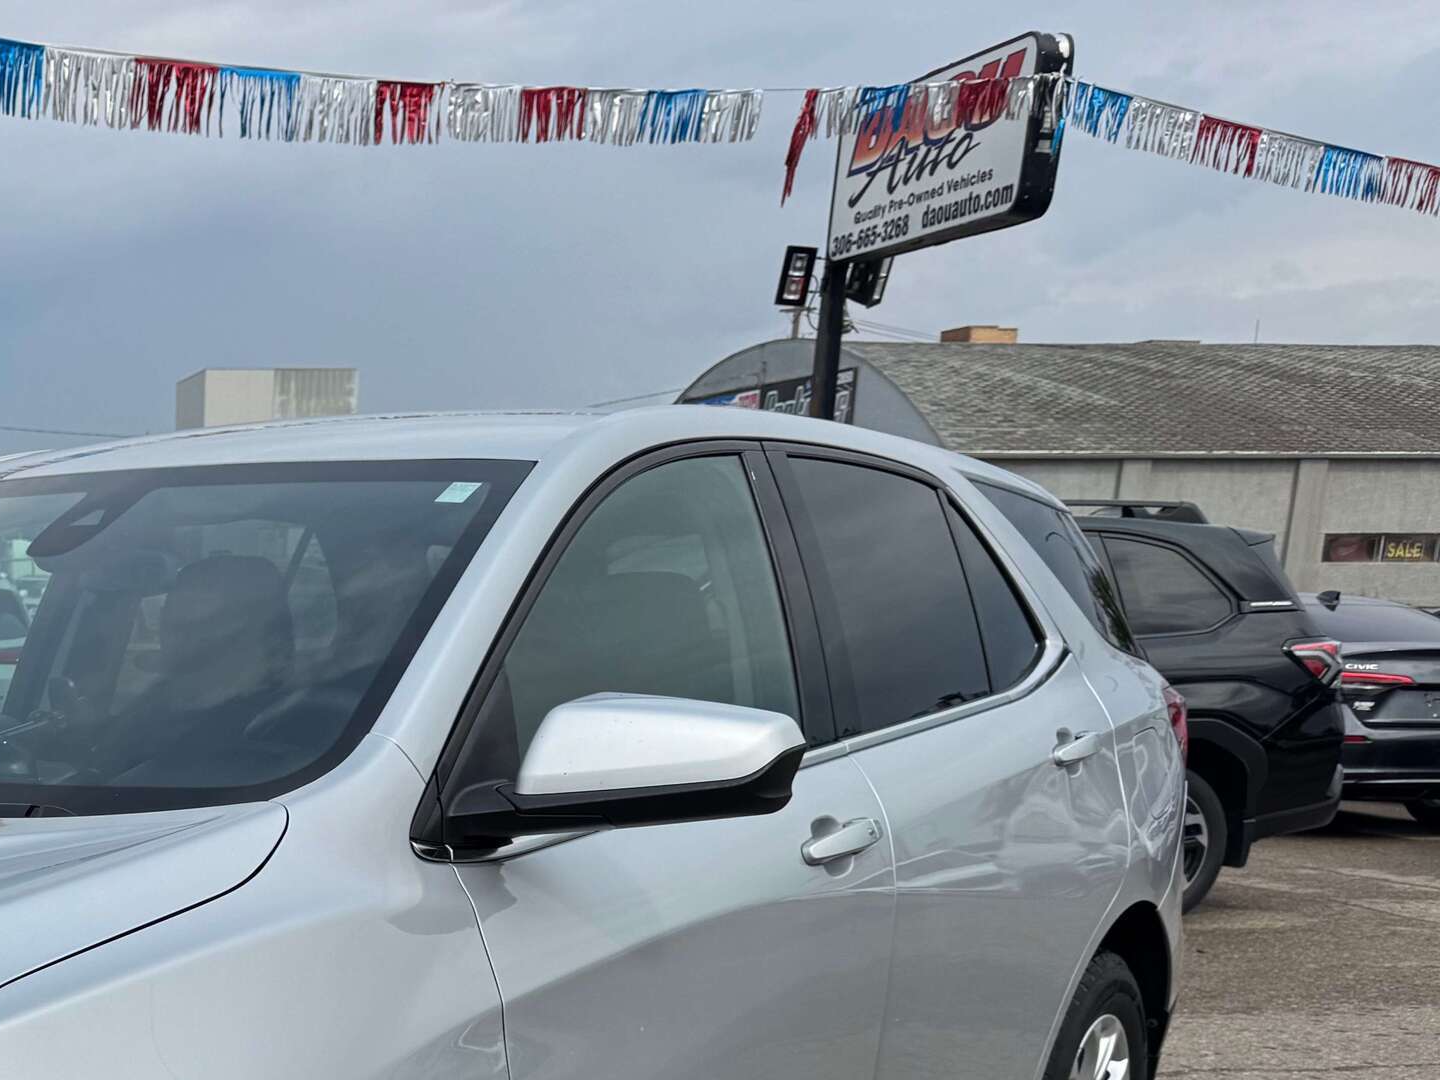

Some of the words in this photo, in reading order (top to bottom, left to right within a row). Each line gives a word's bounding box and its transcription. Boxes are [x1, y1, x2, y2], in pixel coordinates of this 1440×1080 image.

[848, 131, 981, 208] Auto
[854, 203, 886, 225] Quality
[888, 182, 944, 213] Pre-Owned
[946, 168, 994, 194] Vehicles
[831, 214, 910, 257] 306-665-3268
[921, 183, 1015, 229] daouauto.com
[1386, 542, 1423, 558] SALE
